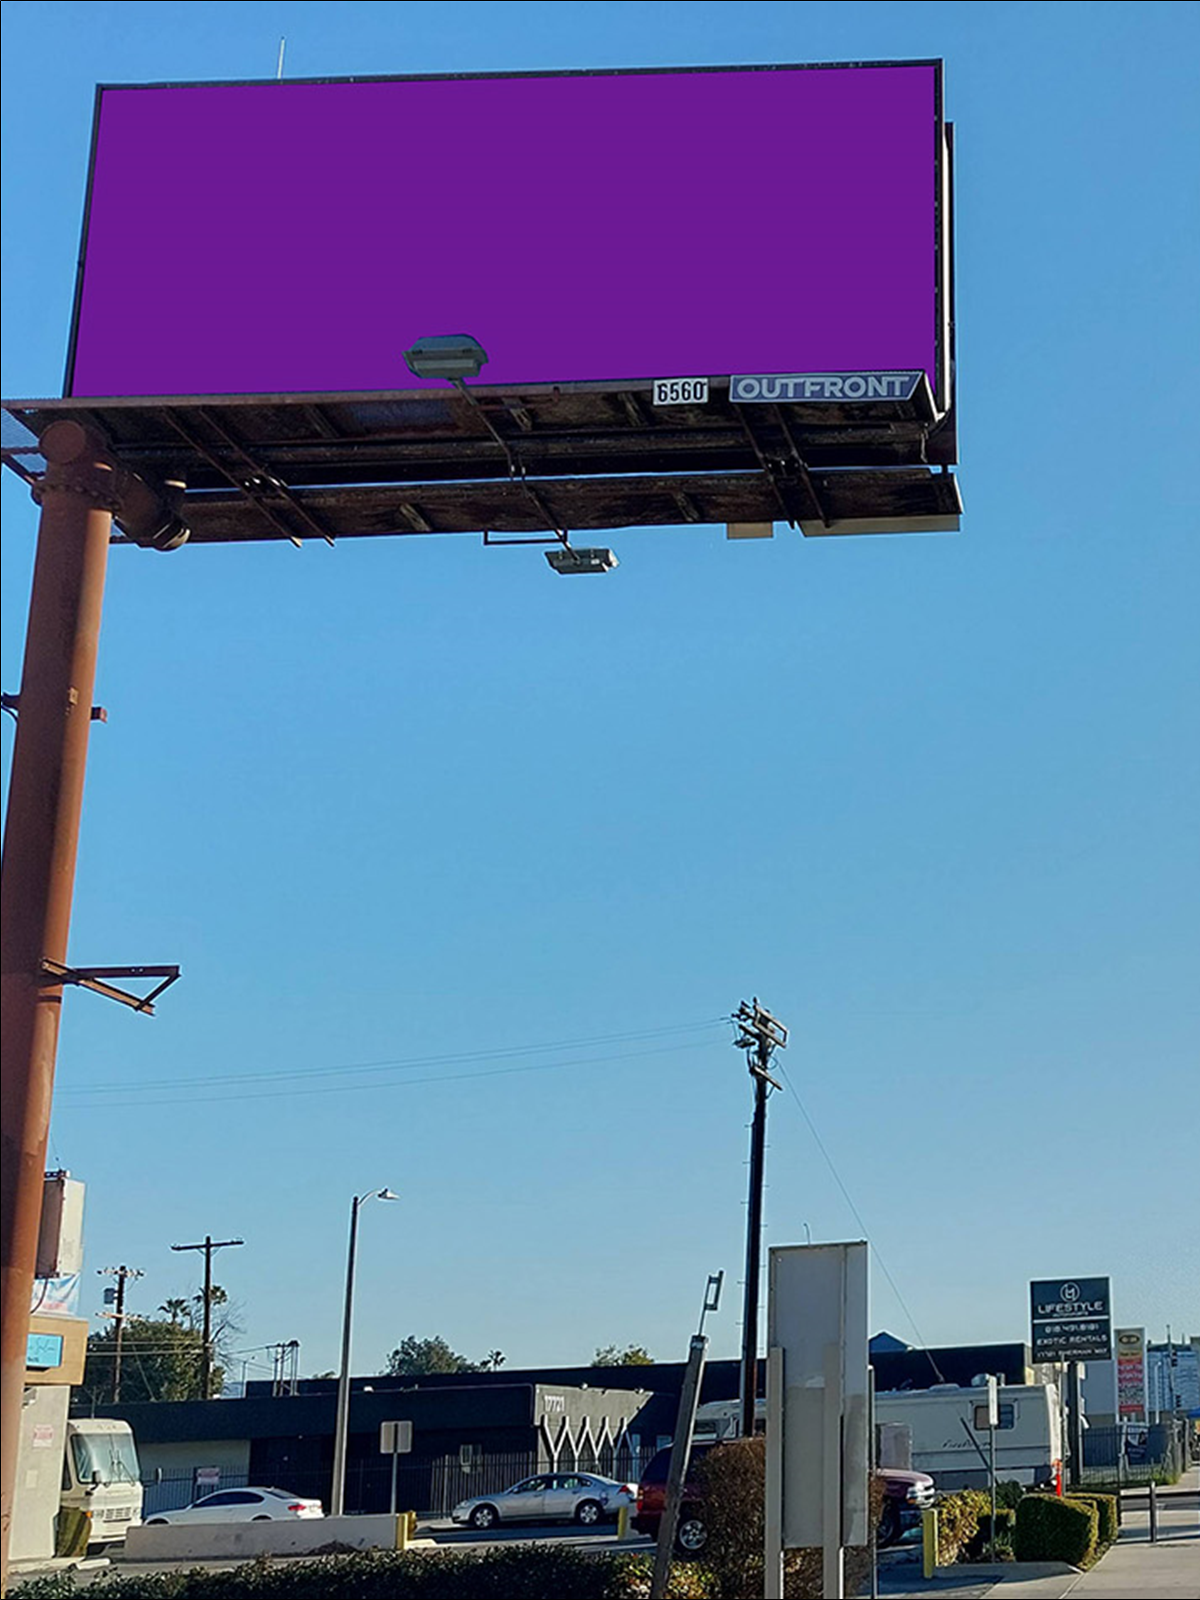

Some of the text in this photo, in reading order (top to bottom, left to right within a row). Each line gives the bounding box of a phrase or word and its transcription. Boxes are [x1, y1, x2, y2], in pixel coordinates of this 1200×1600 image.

[656, 381, 706, 402] 6560
[737, 375, 911, 399] OUTFRONT
[1037, 1301, 1104, 1314] LIFESTYLE
